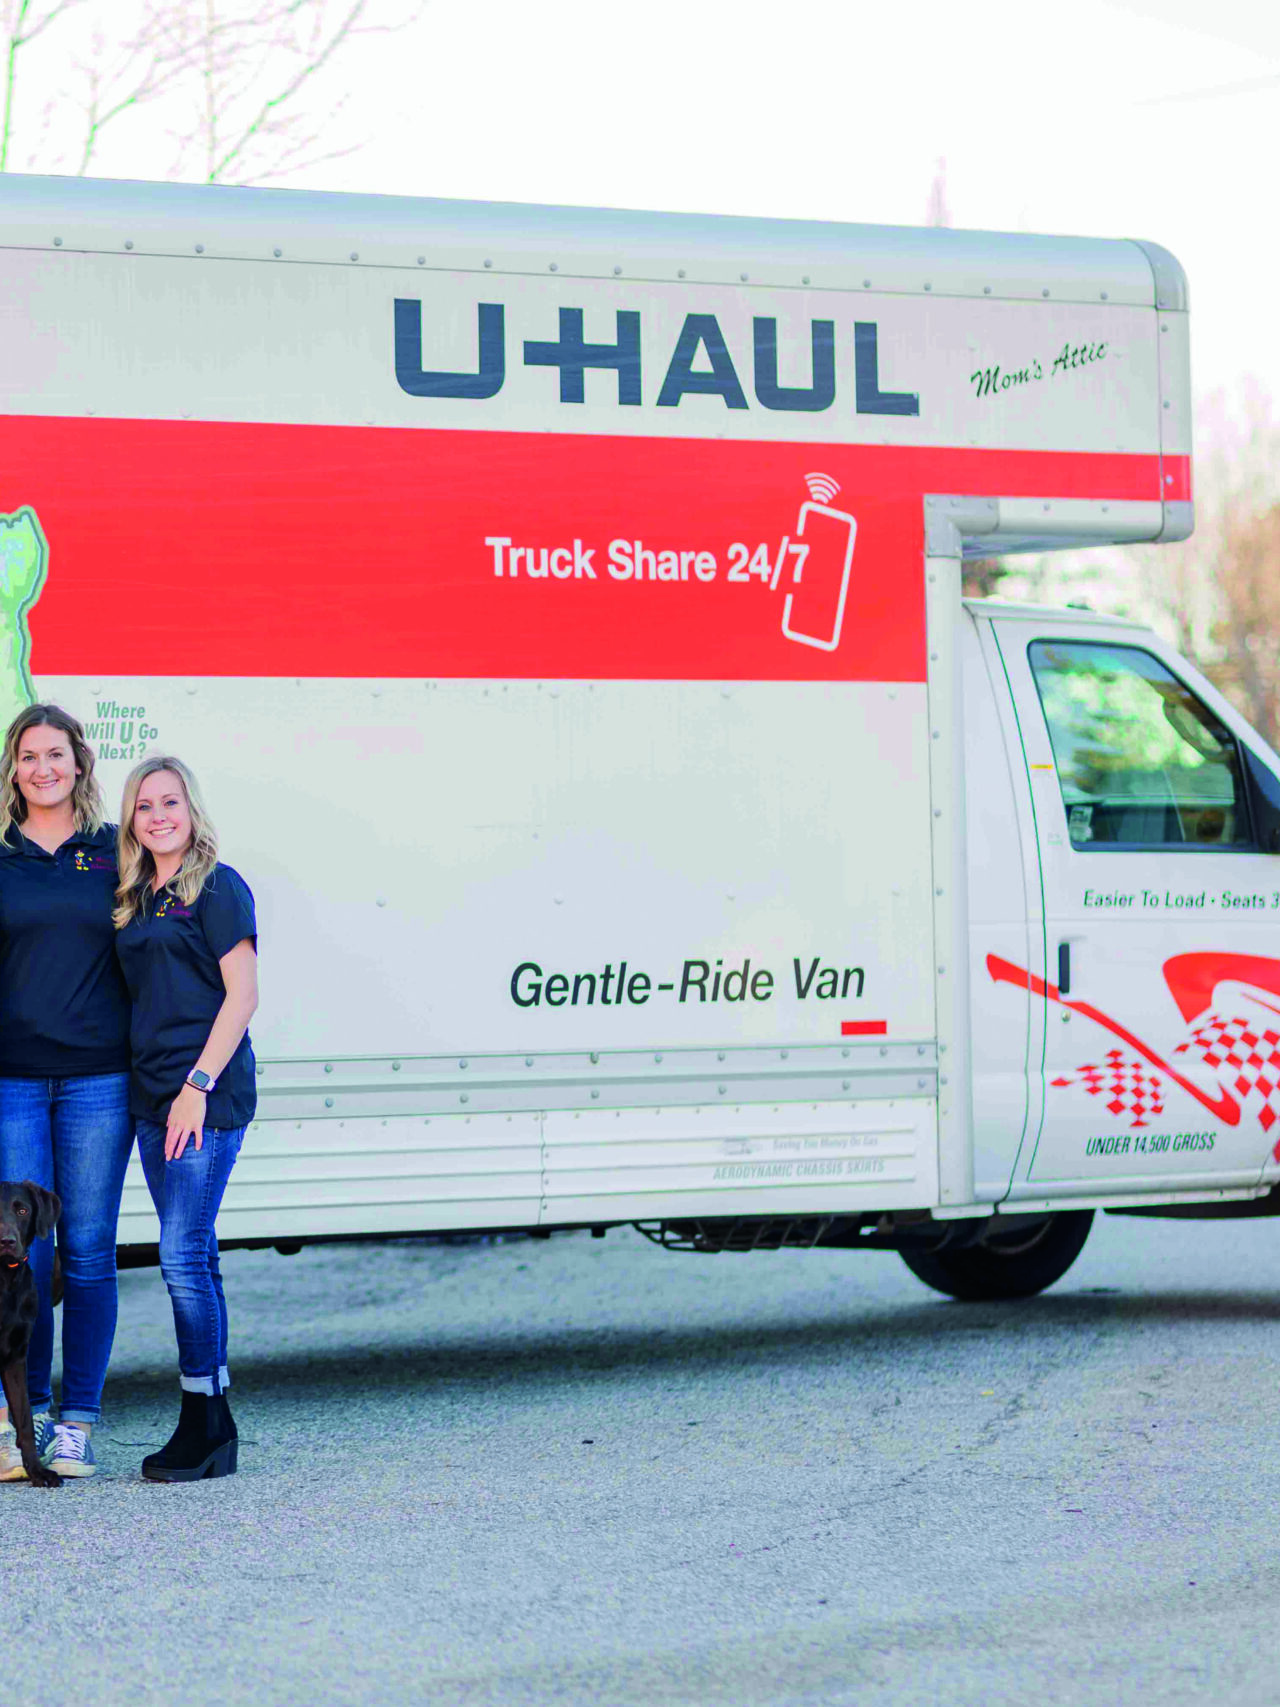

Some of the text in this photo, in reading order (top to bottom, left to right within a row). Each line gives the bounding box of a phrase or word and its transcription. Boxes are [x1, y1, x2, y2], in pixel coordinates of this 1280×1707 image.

[394, 298, 919, 417] U-HAUL
[970, 342, 1109, 397] Mom's Attic
[484, 536, 810, 590] Truck Share 24/7
[96, 701, 146, 718] Where
[85, 721, 158, 744] Will U Go
[1083, 889, 1134, 908] Easier
[1141, 889, 1160, 908] To
[1164, 890, 1206, 908] Load
[1221, 890, 1266, 909] Seats
[510, 957, 865, 1007] Gentle-Ride Van
[1086, 1135, 1131, 1156] UNDER
[1173, 1131, 1217, 1152] GROSS
[797, 1161, 842, 1177] CHASSIS
[847, 1159, 885, 1174] SKIRTS
